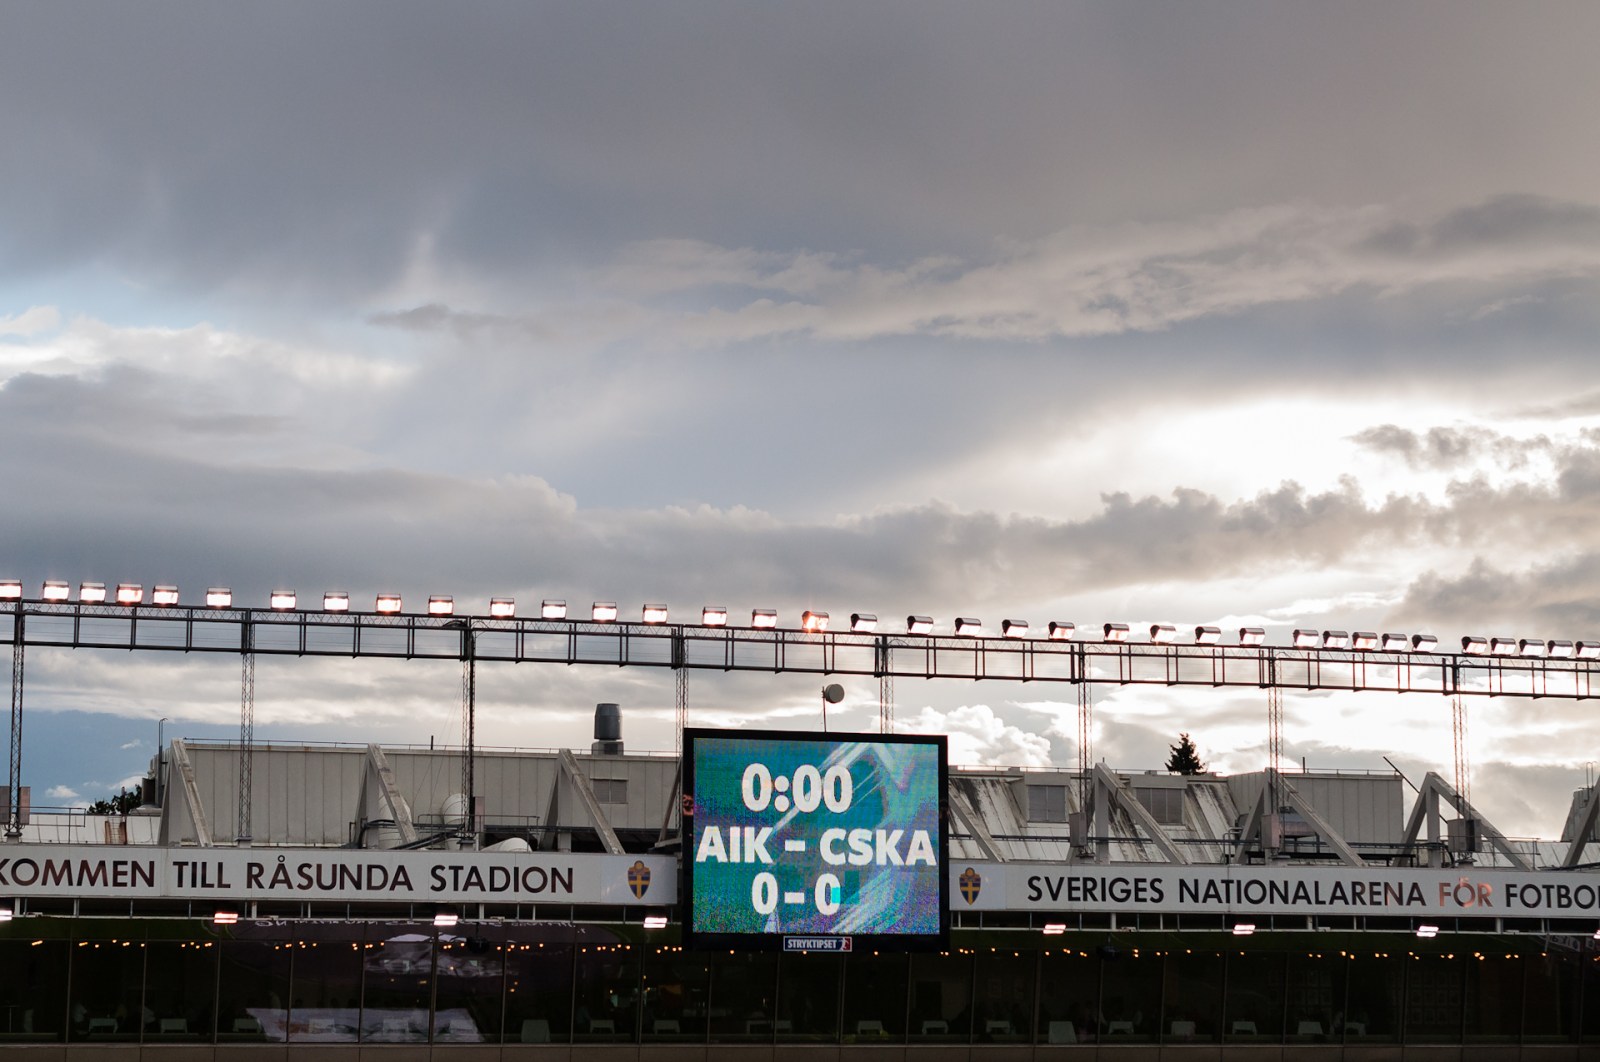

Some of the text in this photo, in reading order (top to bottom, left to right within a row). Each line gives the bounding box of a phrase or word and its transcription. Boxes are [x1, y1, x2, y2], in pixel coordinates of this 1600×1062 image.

[742, 763, 853, 813] 0:00
[695, 825, 774, 863] AIK
[819, 828, 937, 866] CSKA
[173, 861, 231, 888] TILL
[247, 855, 414, 892] RÅSUNDA
[430, 864, 573, 893] STADION
[1027, 875, 1600, 909] SVERIGES NATIONALARENA FÖR FOTBO
[787, 939, 838, 949] STRYKTIPSET
